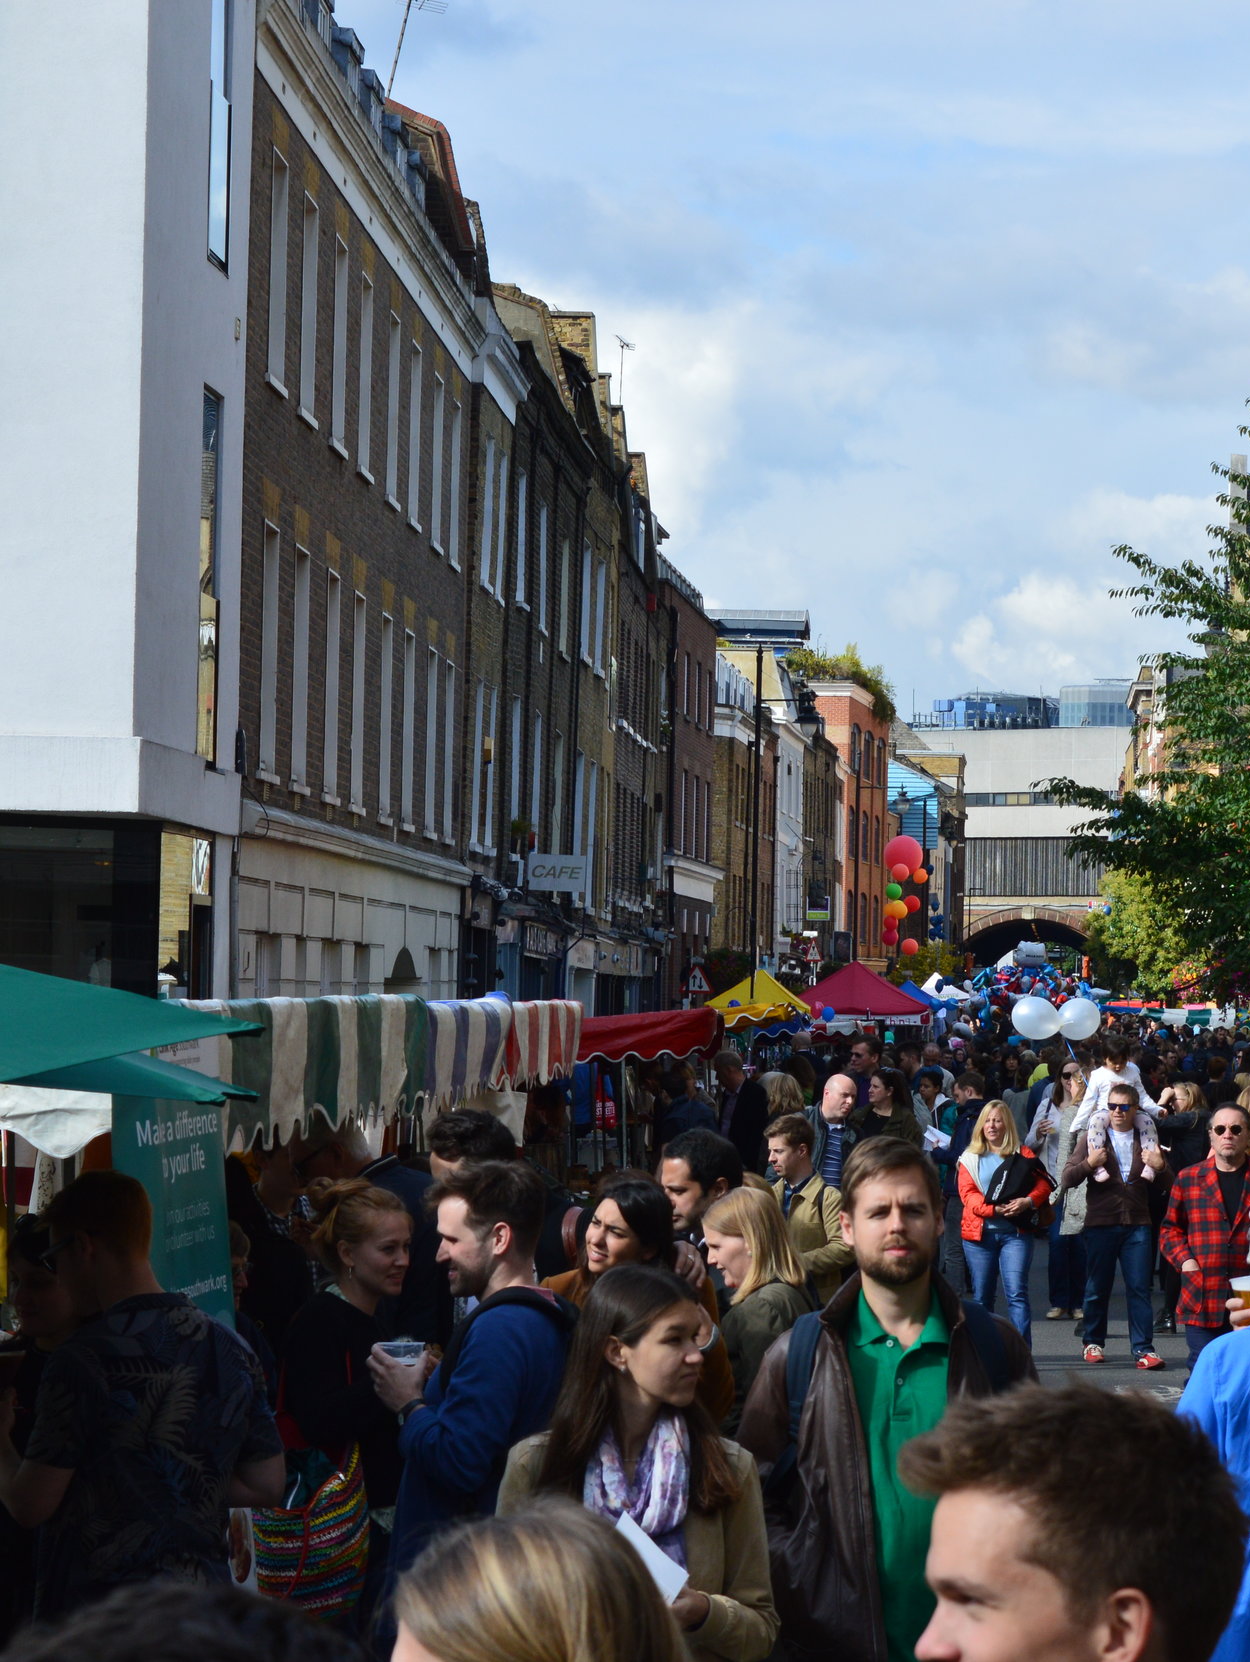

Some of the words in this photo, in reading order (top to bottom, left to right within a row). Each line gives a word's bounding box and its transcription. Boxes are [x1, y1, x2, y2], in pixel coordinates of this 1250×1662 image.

[531, 864, 583, 881] CAFE
[166, 1121, 174, 1142] a
[175, 1110, 218, 1141] difference
[169, 1155, 191, 1183] your
[191, 1143, 206, 1172] life
